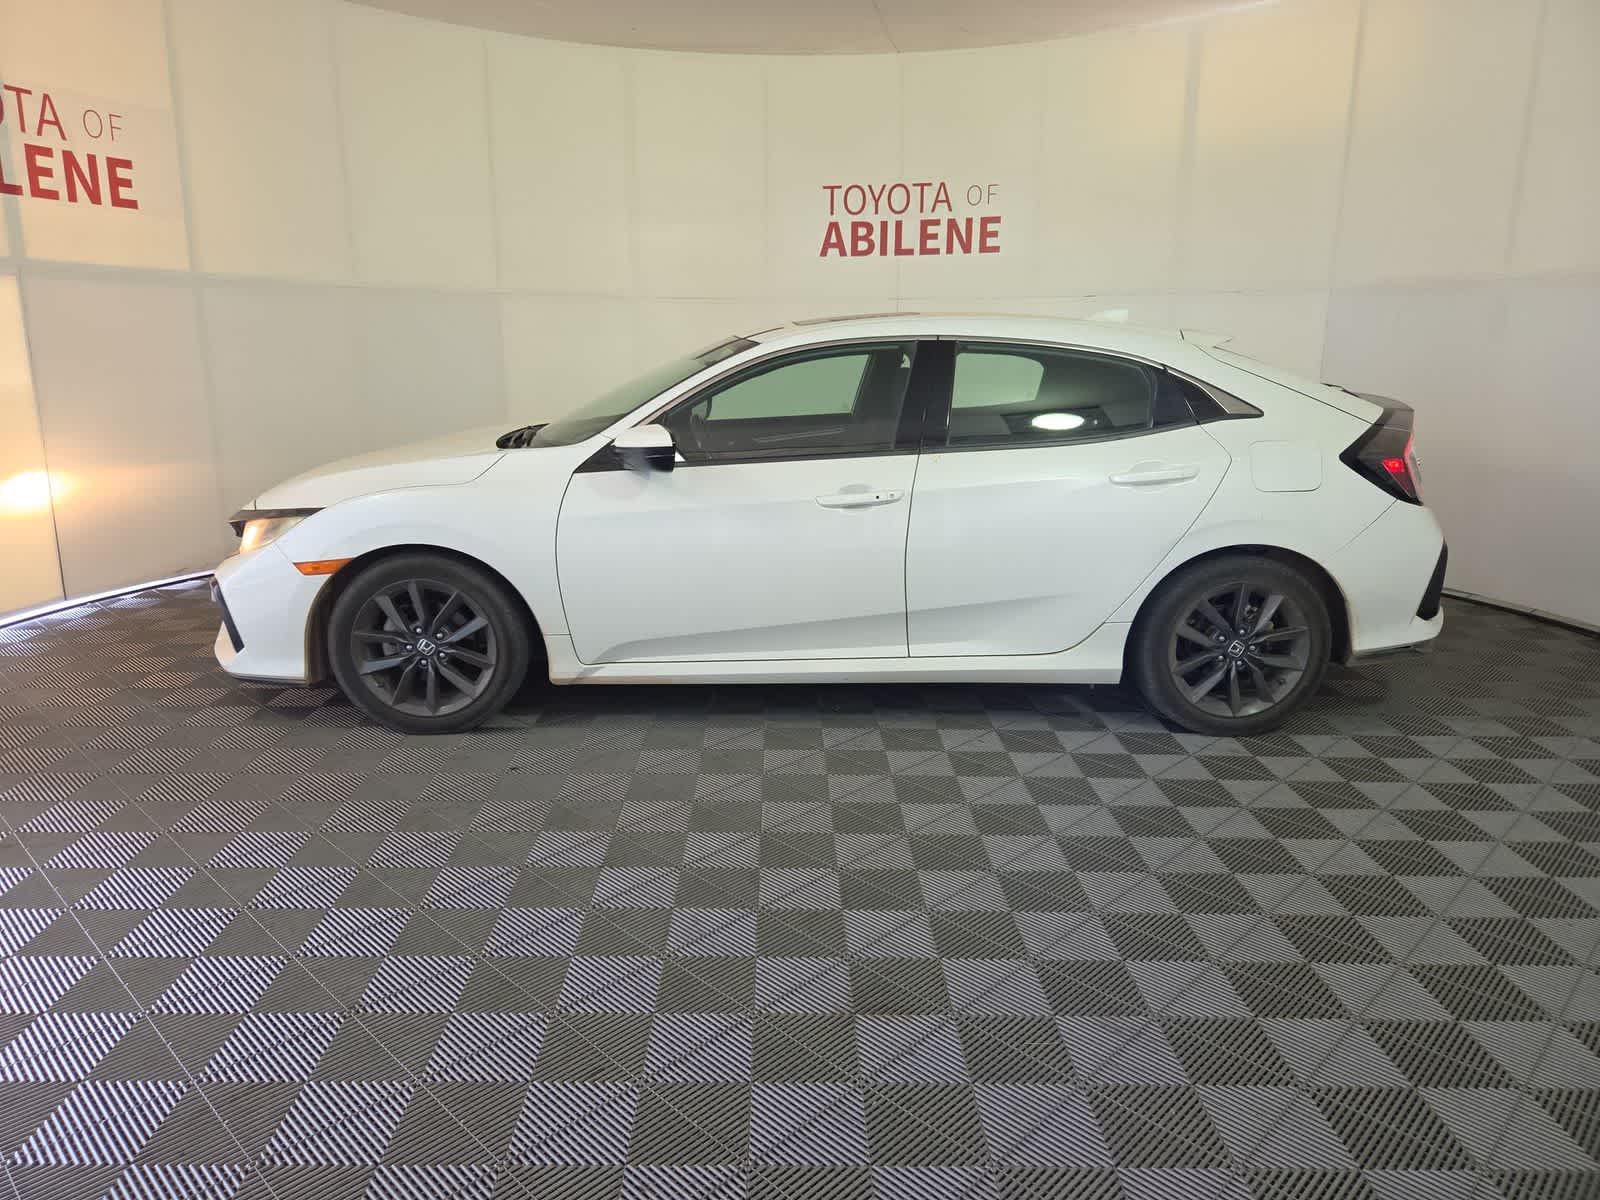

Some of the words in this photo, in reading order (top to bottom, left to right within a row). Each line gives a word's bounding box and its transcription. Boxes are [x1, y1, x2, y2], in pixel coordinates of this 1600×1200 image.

[0, 84, 67, 140] TA
[83, 109, 122, 141] OF
[822, 182, 952, 216] TOYOTA
[966, 184, 1000, 207] OF
[819, 216, 1001, 257] ABILENE
